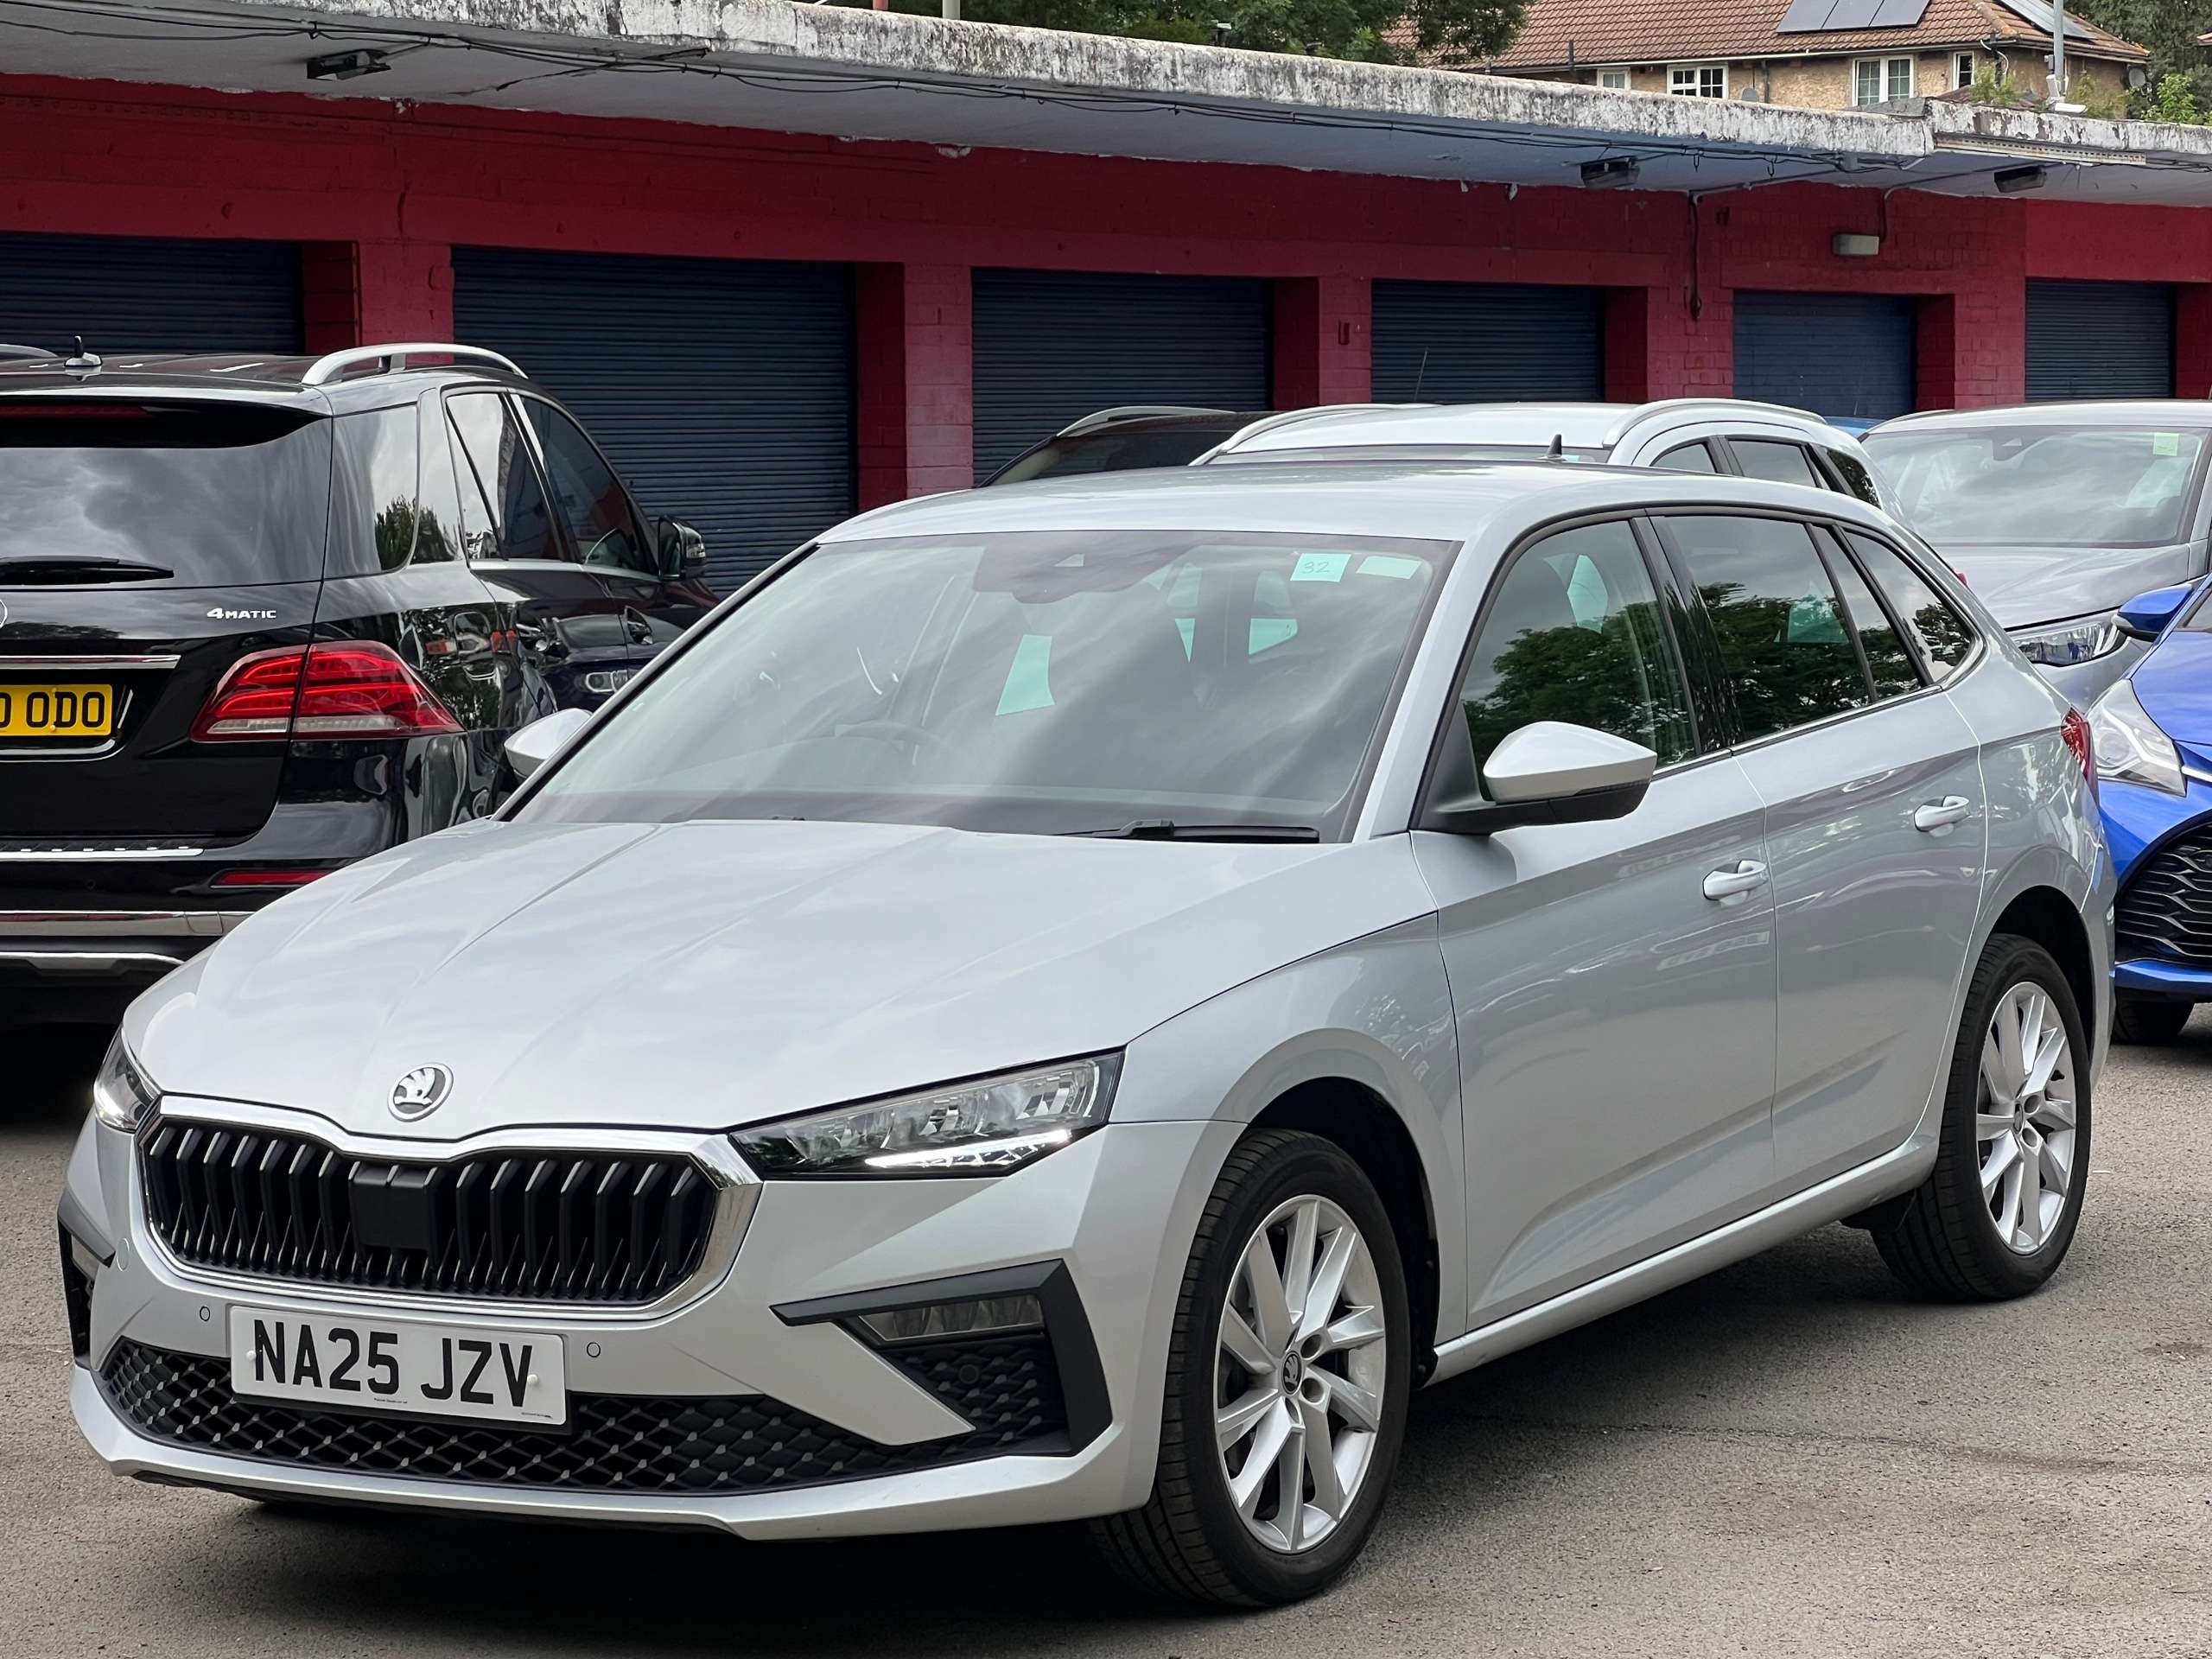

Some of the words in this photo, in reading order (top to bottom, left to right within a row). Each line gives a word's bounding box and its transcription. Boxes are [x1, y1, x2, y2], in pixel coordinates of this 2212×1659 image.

[207, 607, 276, 619] 4MATIC
[26, 690, 105, 728] ODO
[254, 1319, 400, 1395] NA25
[420, 1338, 533, 1408] JZV
